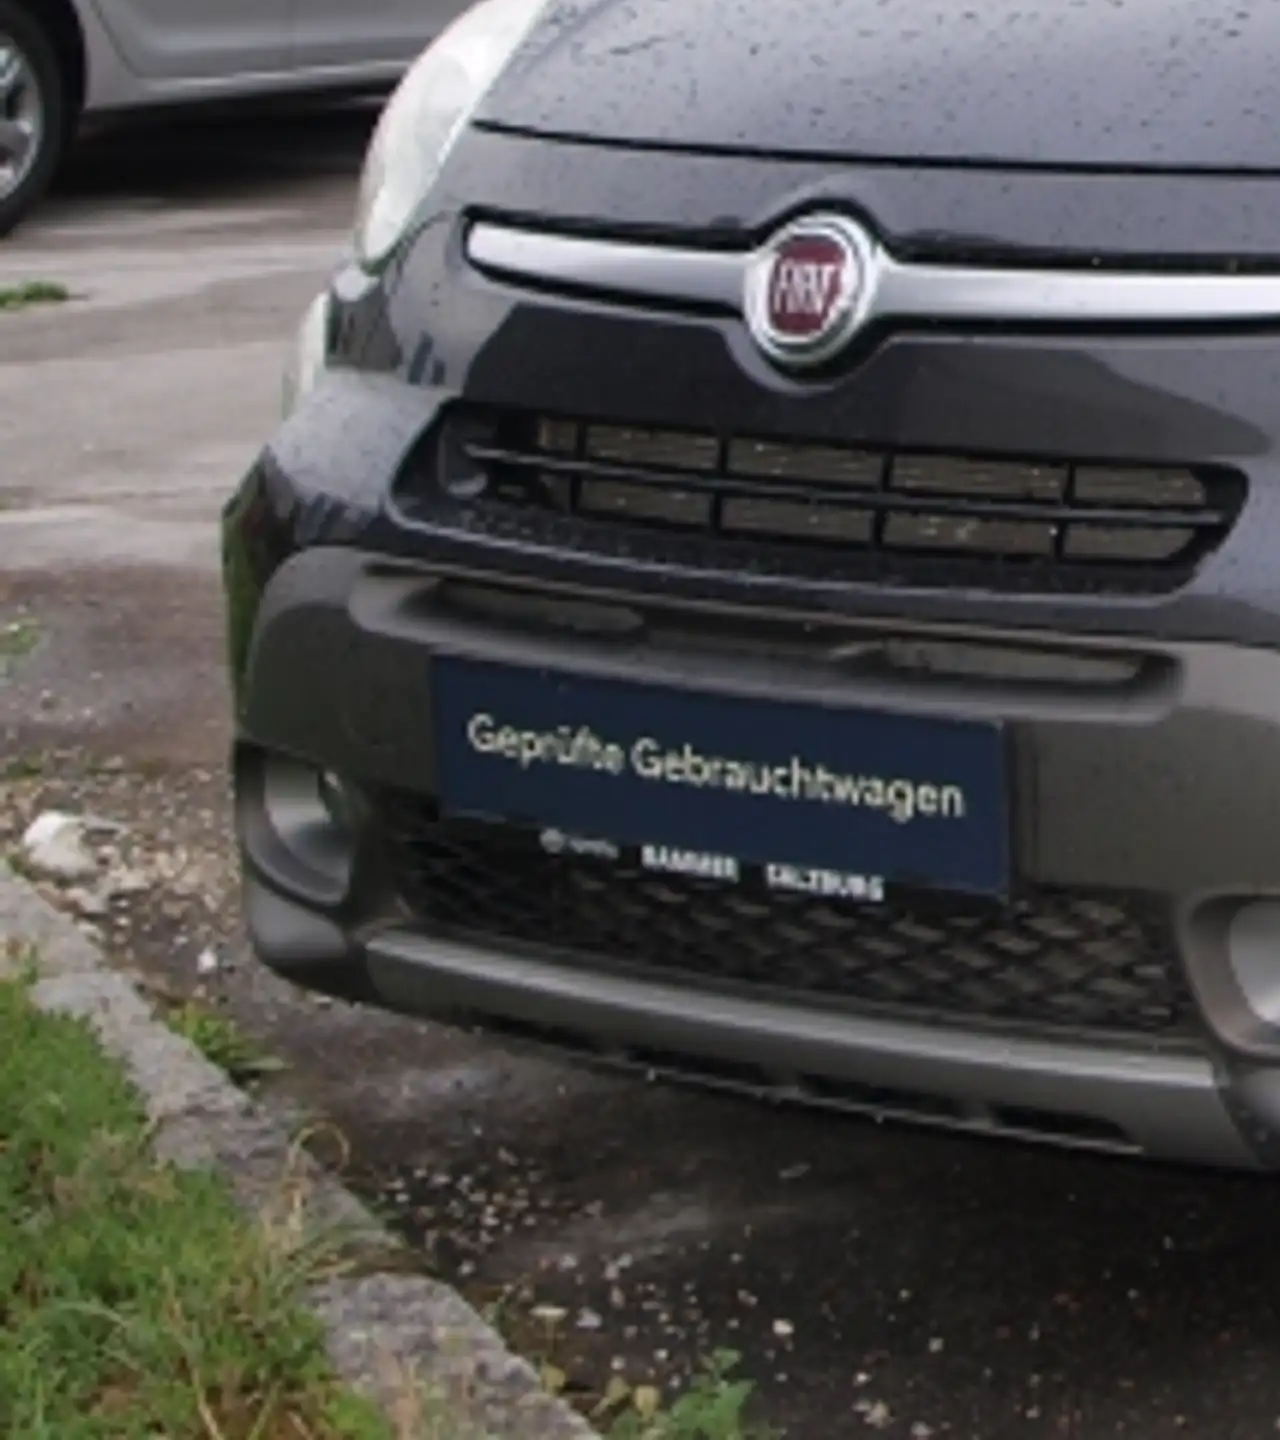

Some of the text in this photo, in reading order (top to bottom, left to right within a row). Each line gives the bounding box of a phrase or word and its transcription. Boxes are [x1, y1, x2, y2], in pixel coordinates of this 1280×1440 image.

[773, 260, 838, 314] FIAT
[466, 713, 965, 825] Geprüfte Gebrauchtwagen
